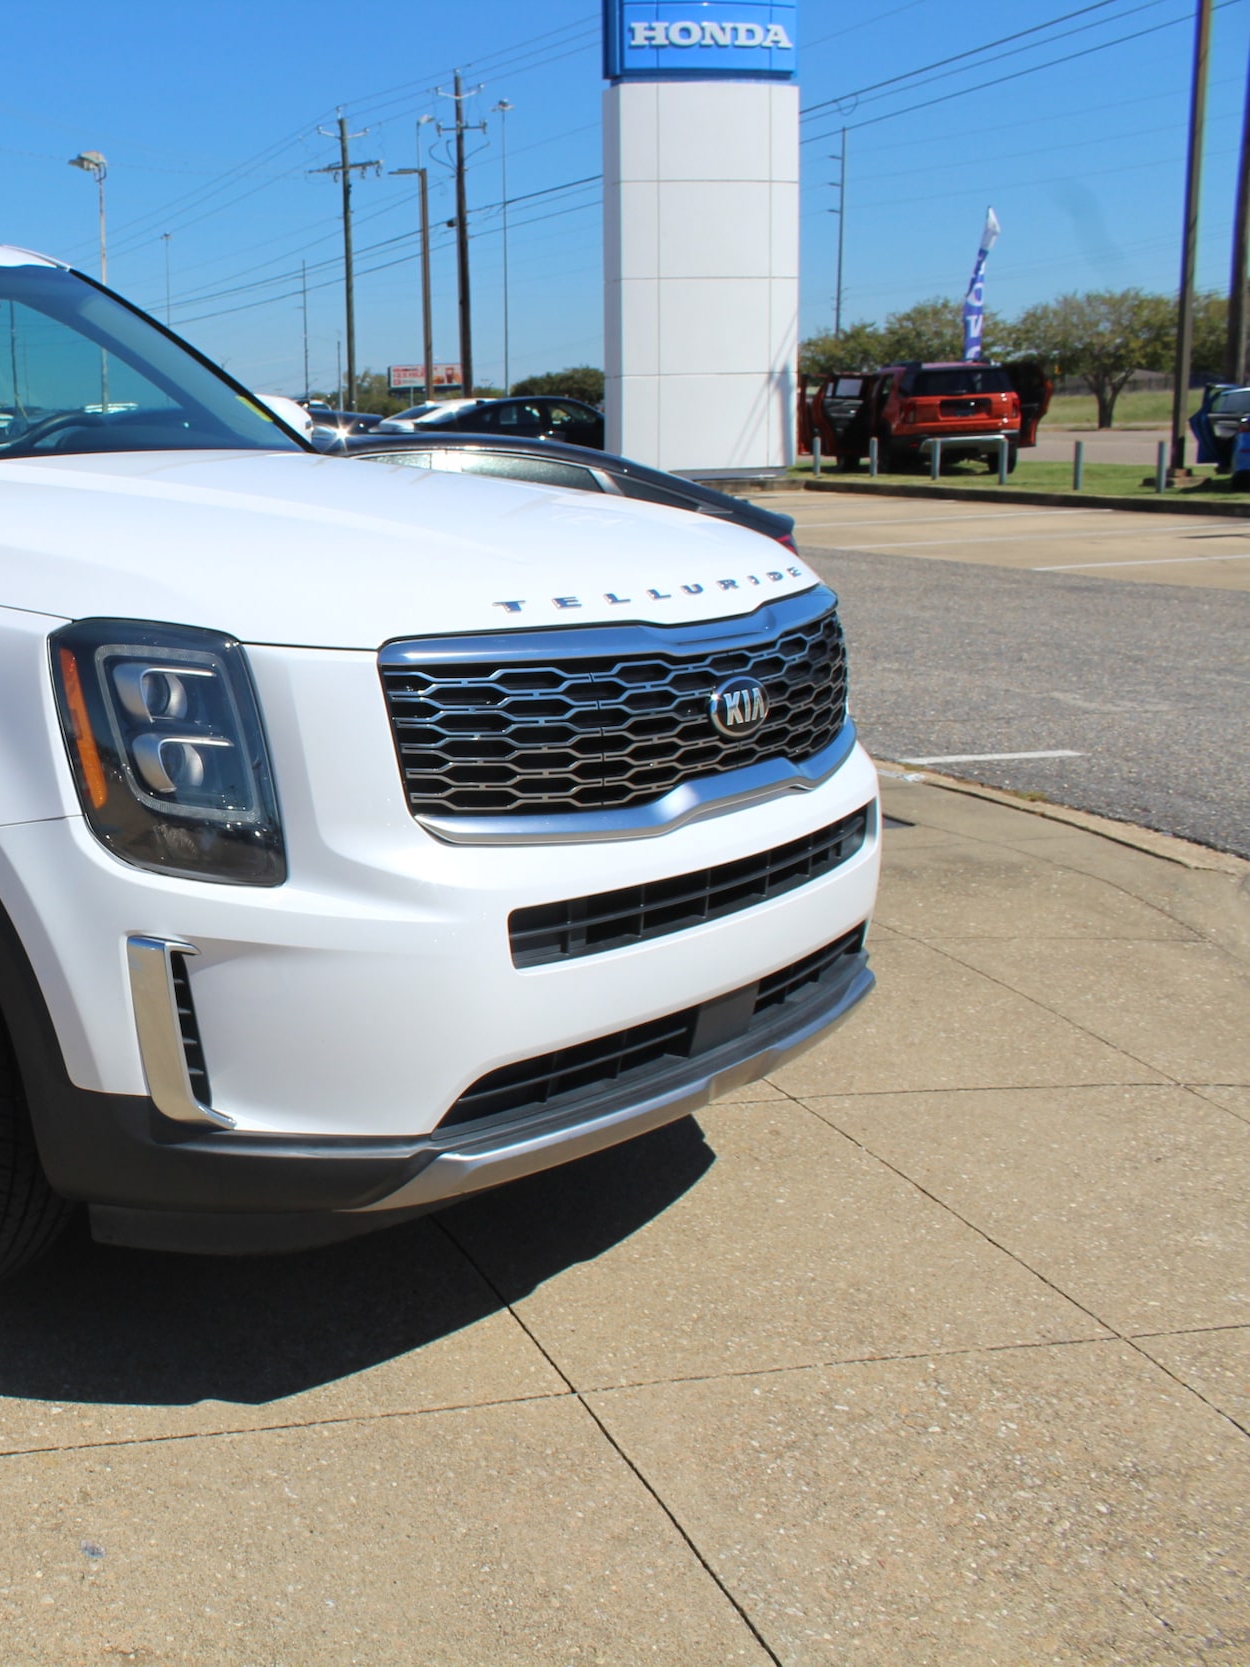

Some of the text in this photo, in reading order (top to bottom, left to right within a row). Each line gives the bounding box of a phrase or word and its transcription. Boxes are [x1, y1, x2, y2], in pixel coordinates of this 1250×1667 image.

[630, 21, 793, 49] HONDA
[493, 565, 802, 613] TELLURIDE
[723, 687, 765, 726] KIA
